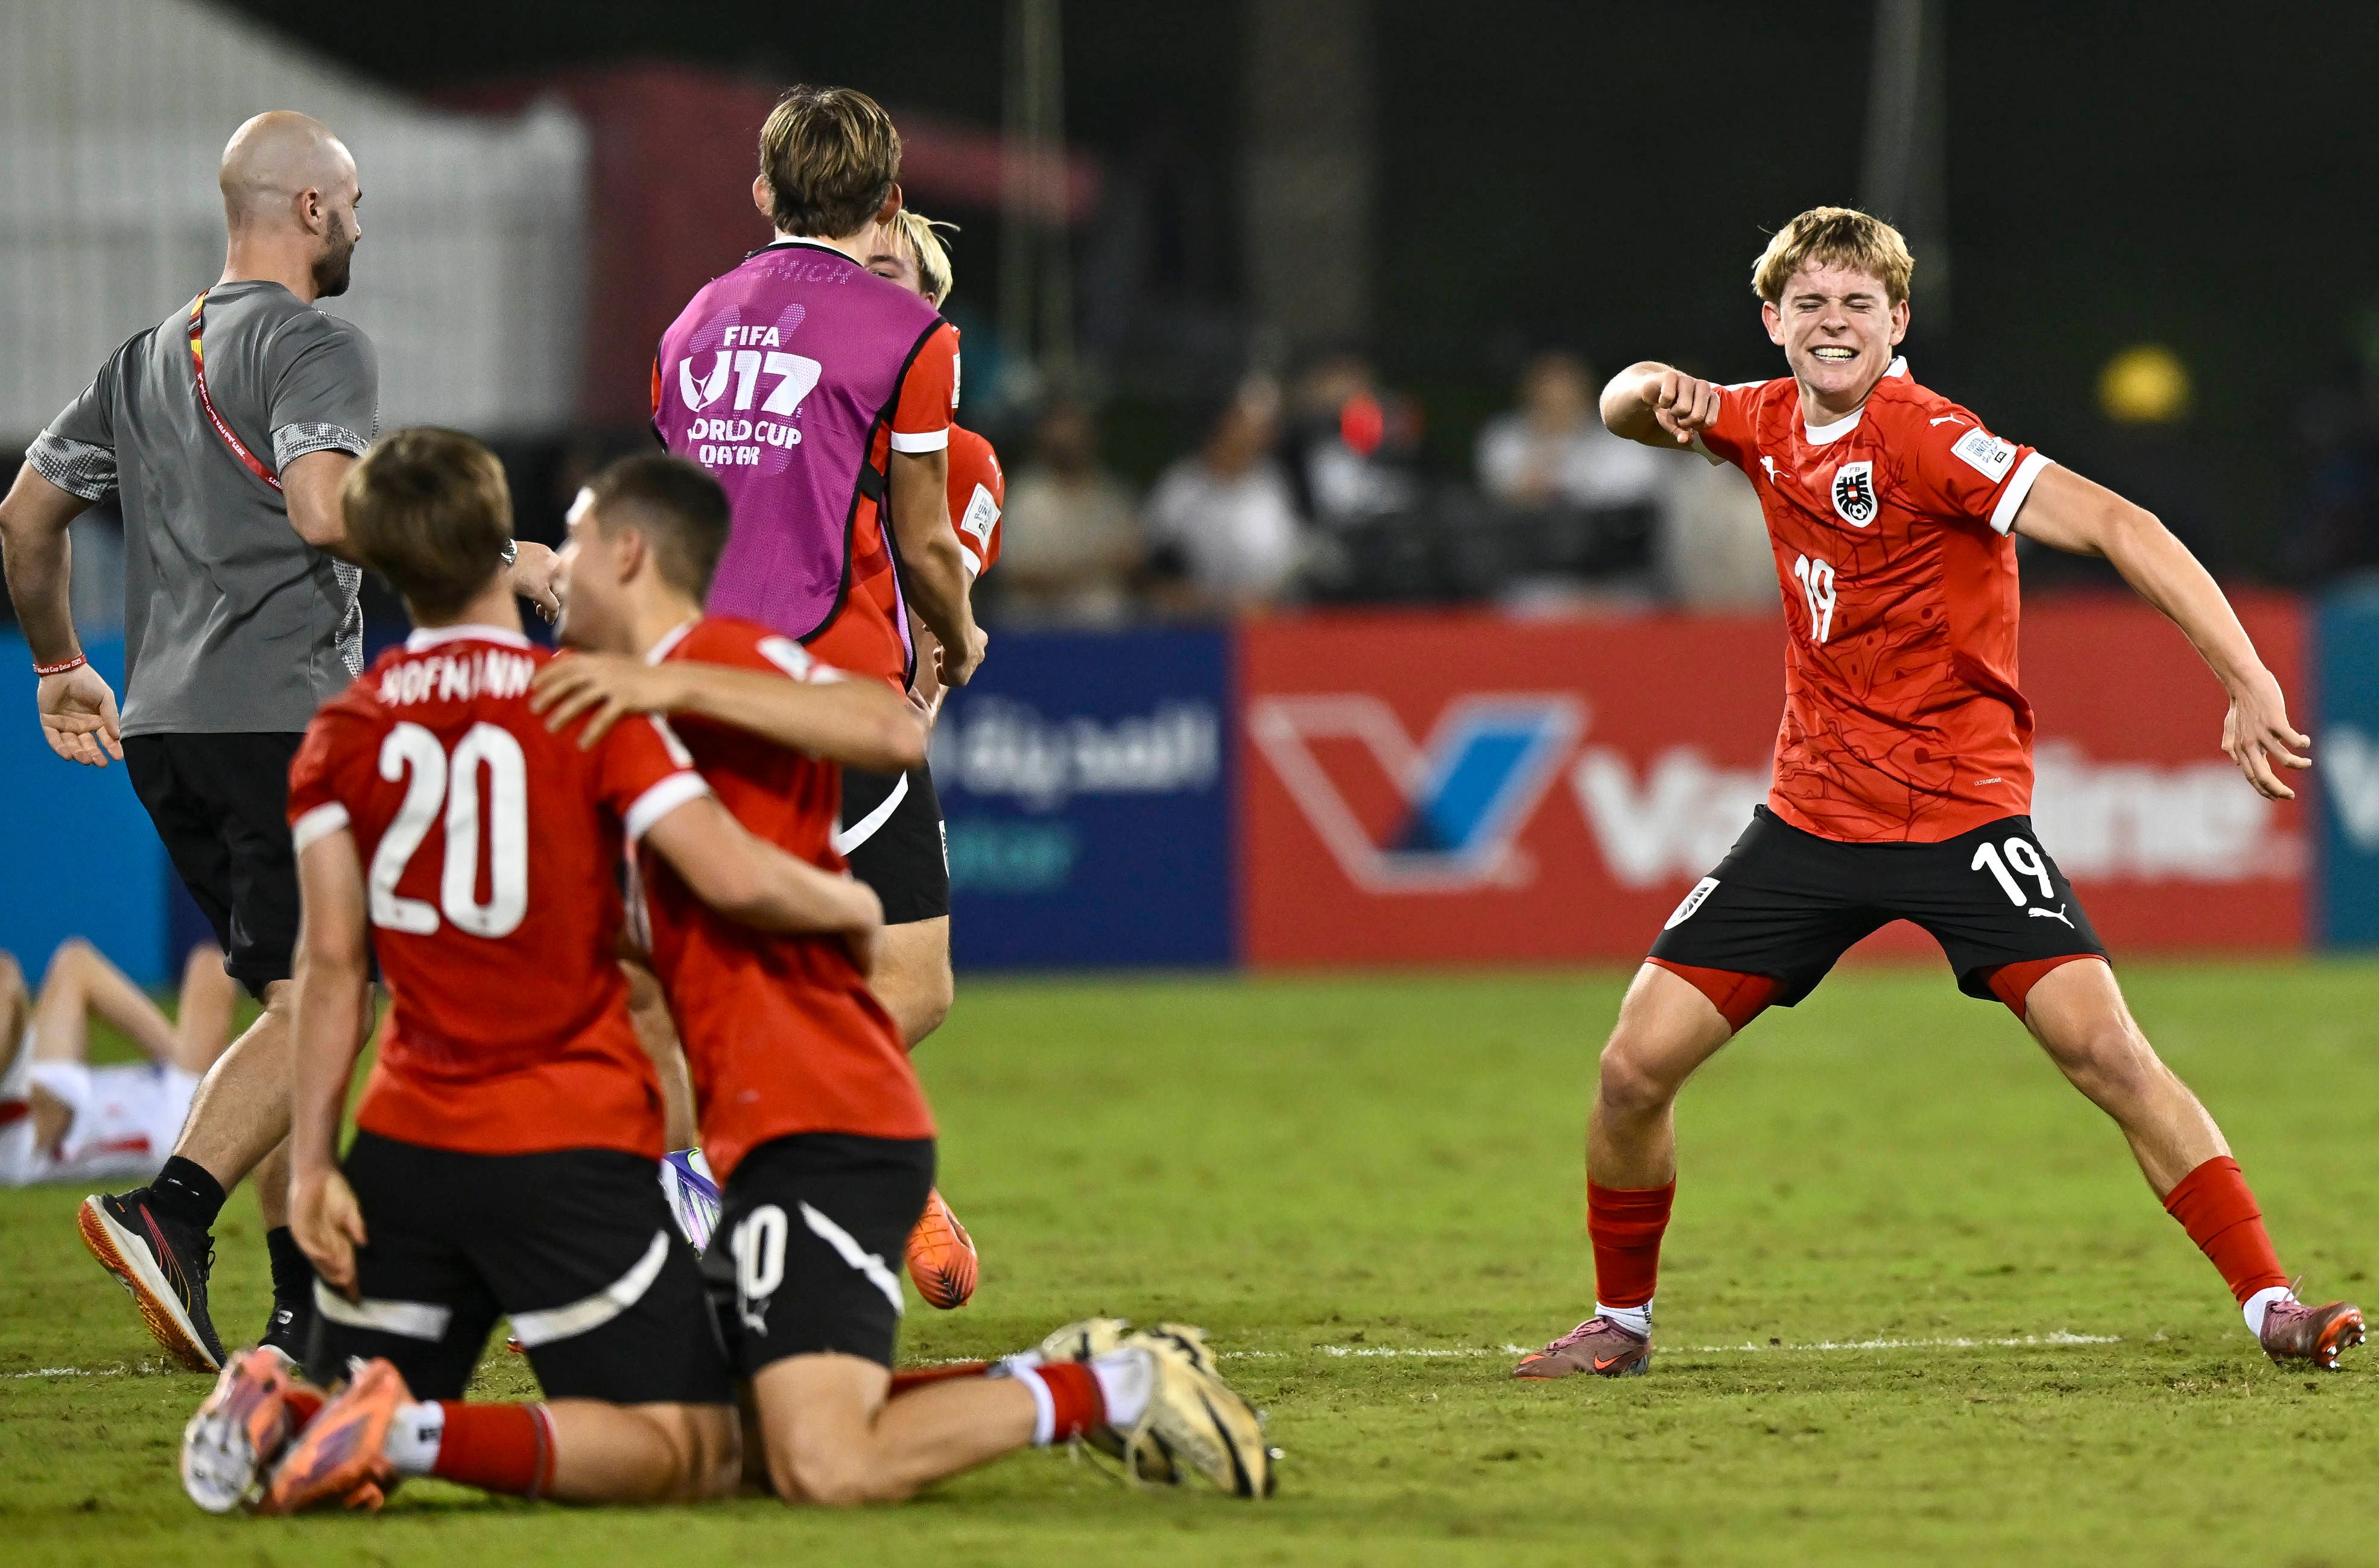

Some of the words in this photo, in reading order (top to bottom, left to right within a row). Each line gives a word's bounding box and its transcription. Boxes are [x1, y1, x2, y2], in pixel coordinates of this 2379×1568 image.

[723, 326, 779, 347] FIFA
[679, 350, 822, 417] U17
[216, 420, 226, 434] FIFA
[232, 441, 246, 457] 2025
[755, 420, 802, 450] CUP
[1795, 554, 1837, 643] 19
[369, 721, 528, 939] 20
[1971, 837, 2054, 906] 19
